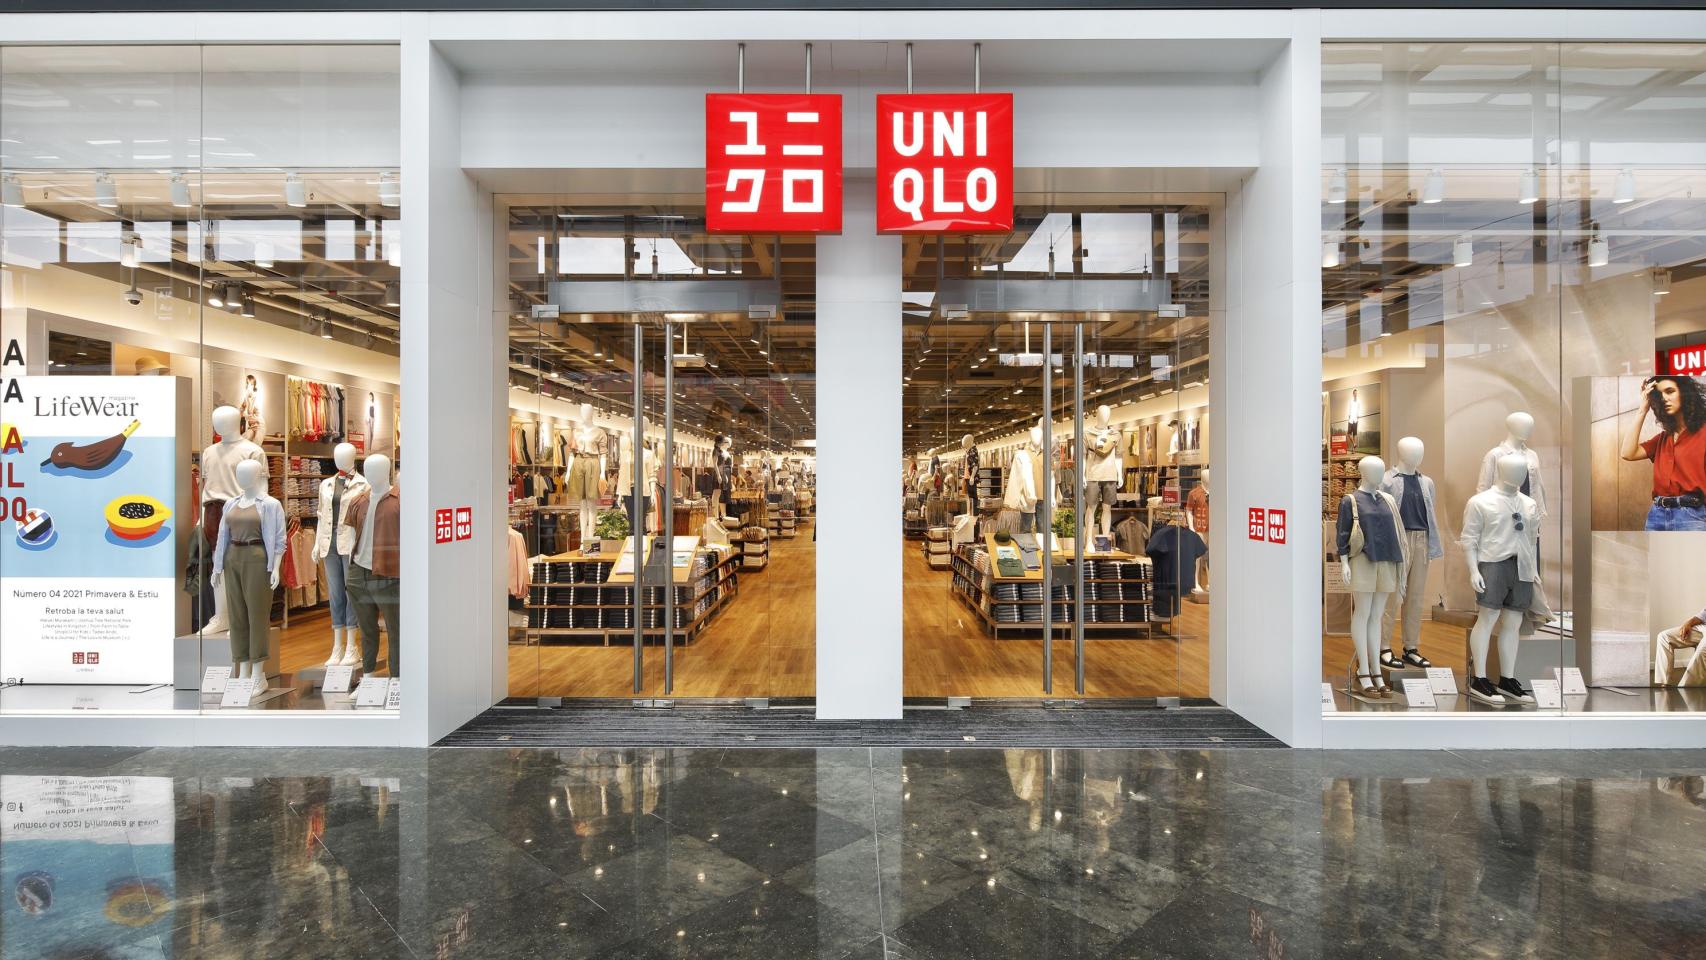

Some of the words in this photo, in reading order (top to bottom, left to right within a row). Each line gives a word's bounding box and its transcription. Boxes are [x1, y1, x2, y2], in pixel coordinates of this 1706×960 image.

[725, 112, 823, 156] ユニ
[893, 111, 987, 156] UNI
[721, 169, 824, 212] クロ
[893, 167, 997, 221] QLO
[34, 396, 139, 417] LifeWear
[1270, 514, 1283, 526] UNI
[1270, 527, 1284, 540] QLO
[63, 590, 82, 598] 2021
[86, 590, 126, 598] Primavera
[129, 590, 135, 598] &
[138, 590, 159, 598] Estiu
